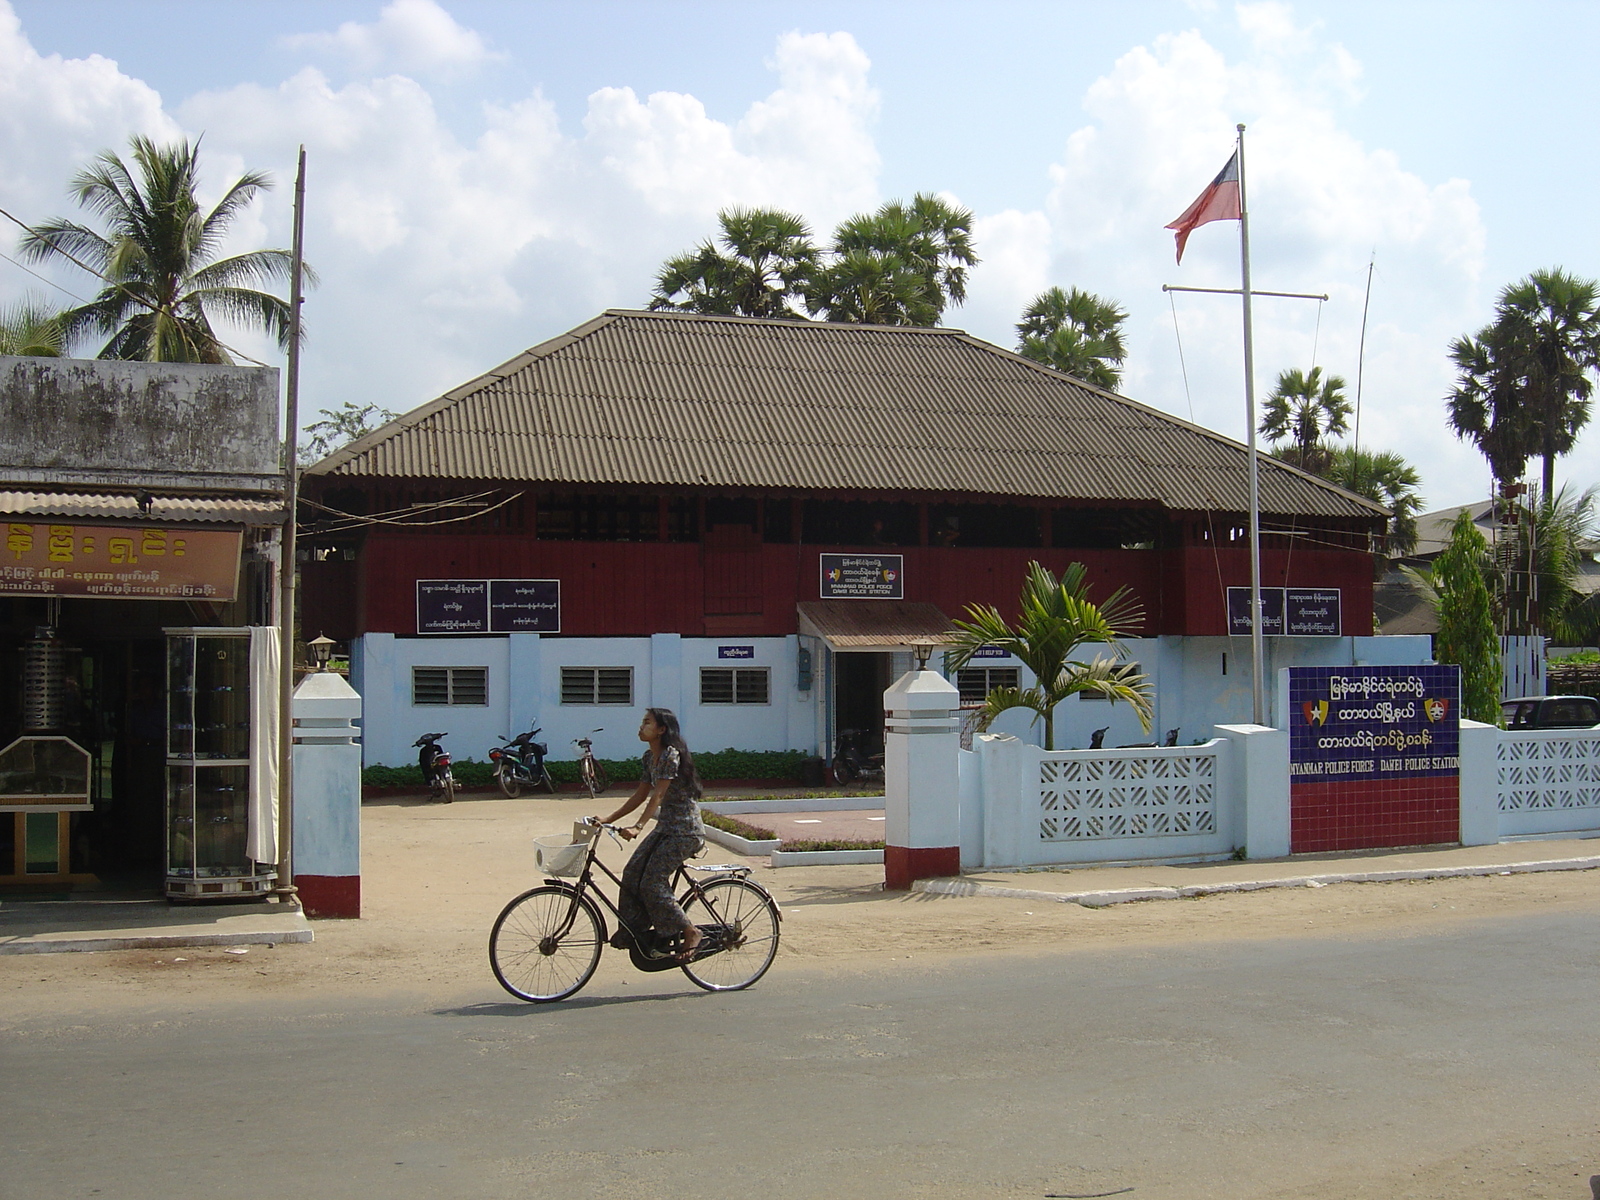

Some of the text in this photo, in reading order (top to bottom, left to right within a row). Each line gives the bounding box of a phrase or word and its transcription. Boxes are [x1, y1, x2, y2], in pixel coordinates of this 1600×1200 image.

[1330, 676, 1425, 701] မြန်မာနိုင်ငံရဲတပ်ဖွဲ့
[1338, 702, 1416, 723] ထားဝယ်မြို့နယ်
[1318, 729, 1433, 751] ထားဝယ်ရဲတပ်ဖွဲ့စခန်း
[1290, 756, 1460, 776] MYANMAR POLICE FORCE DAWEI POLICE STATION
